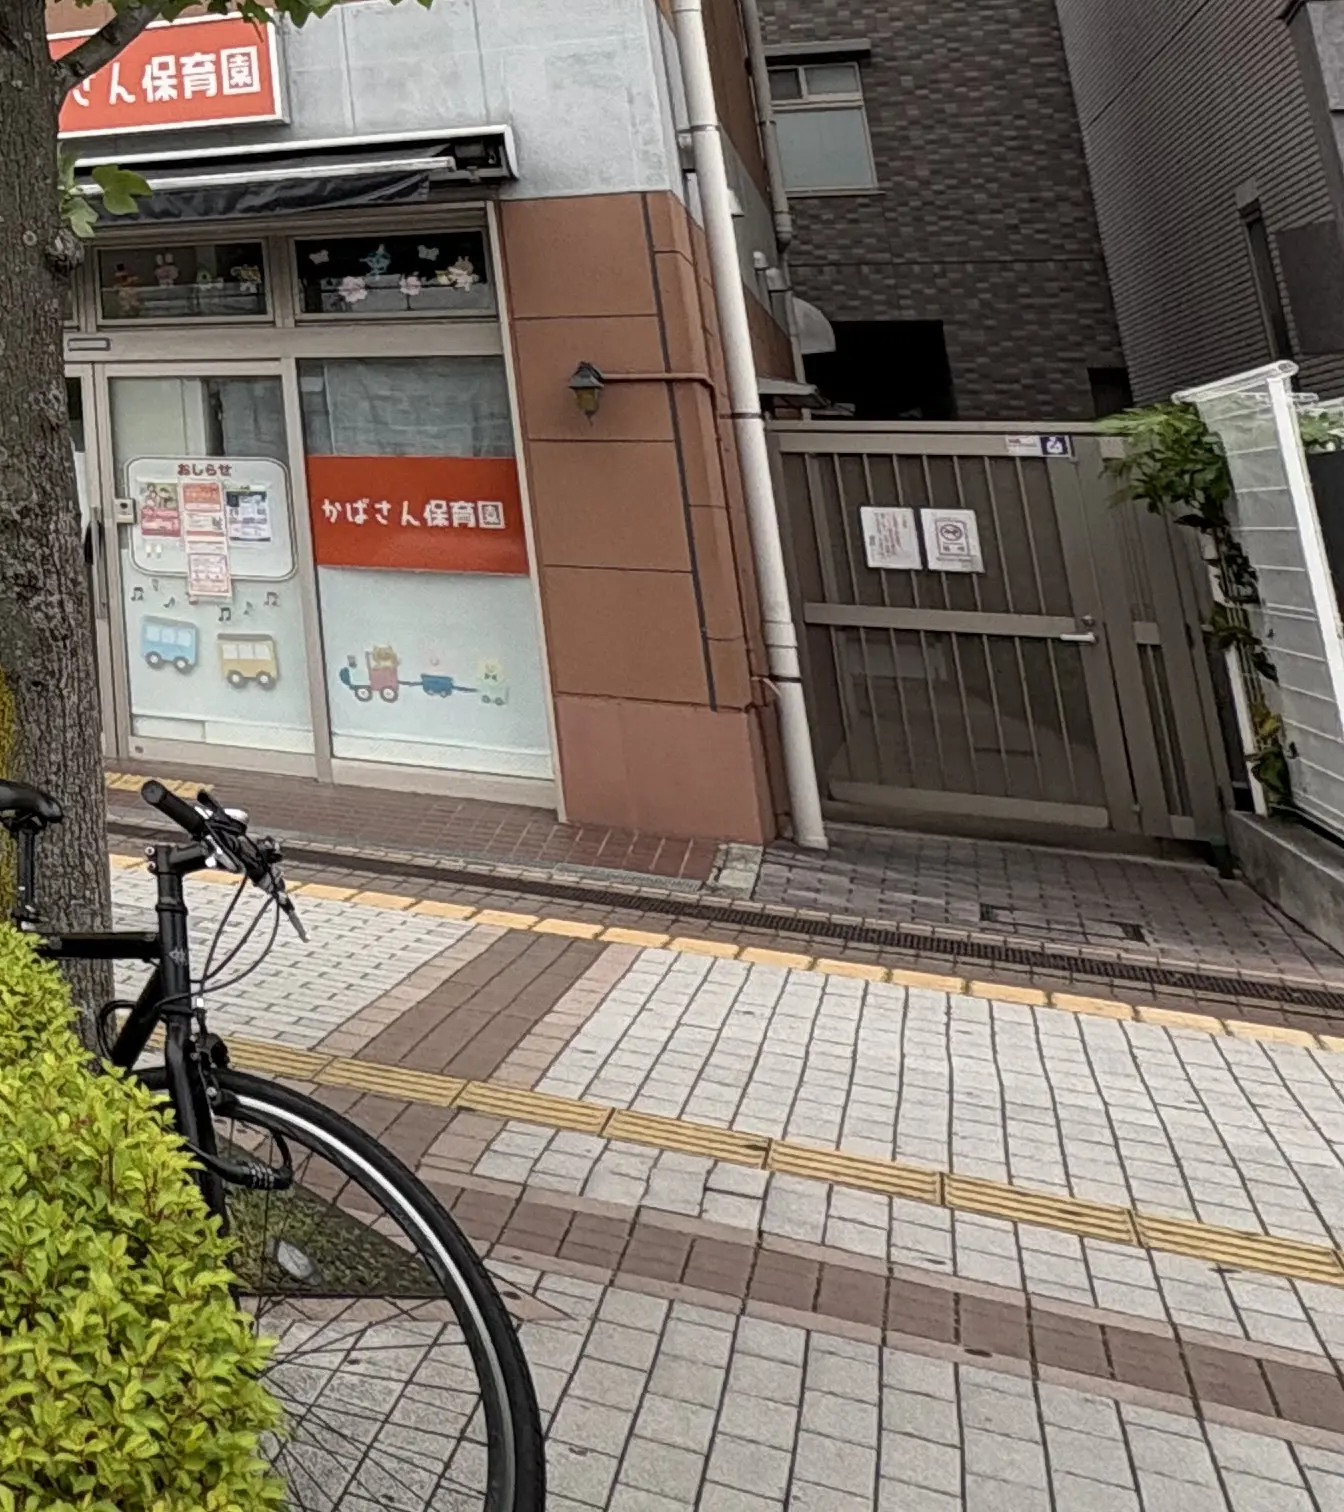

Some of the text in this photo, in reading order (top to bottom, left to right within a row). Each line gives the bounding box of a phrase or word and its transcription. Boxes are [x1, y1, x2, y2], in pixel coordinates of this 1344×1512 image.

[176, 463, 233, 477] おしらせ
[321, 498, 506, 530] かばさん保育園
